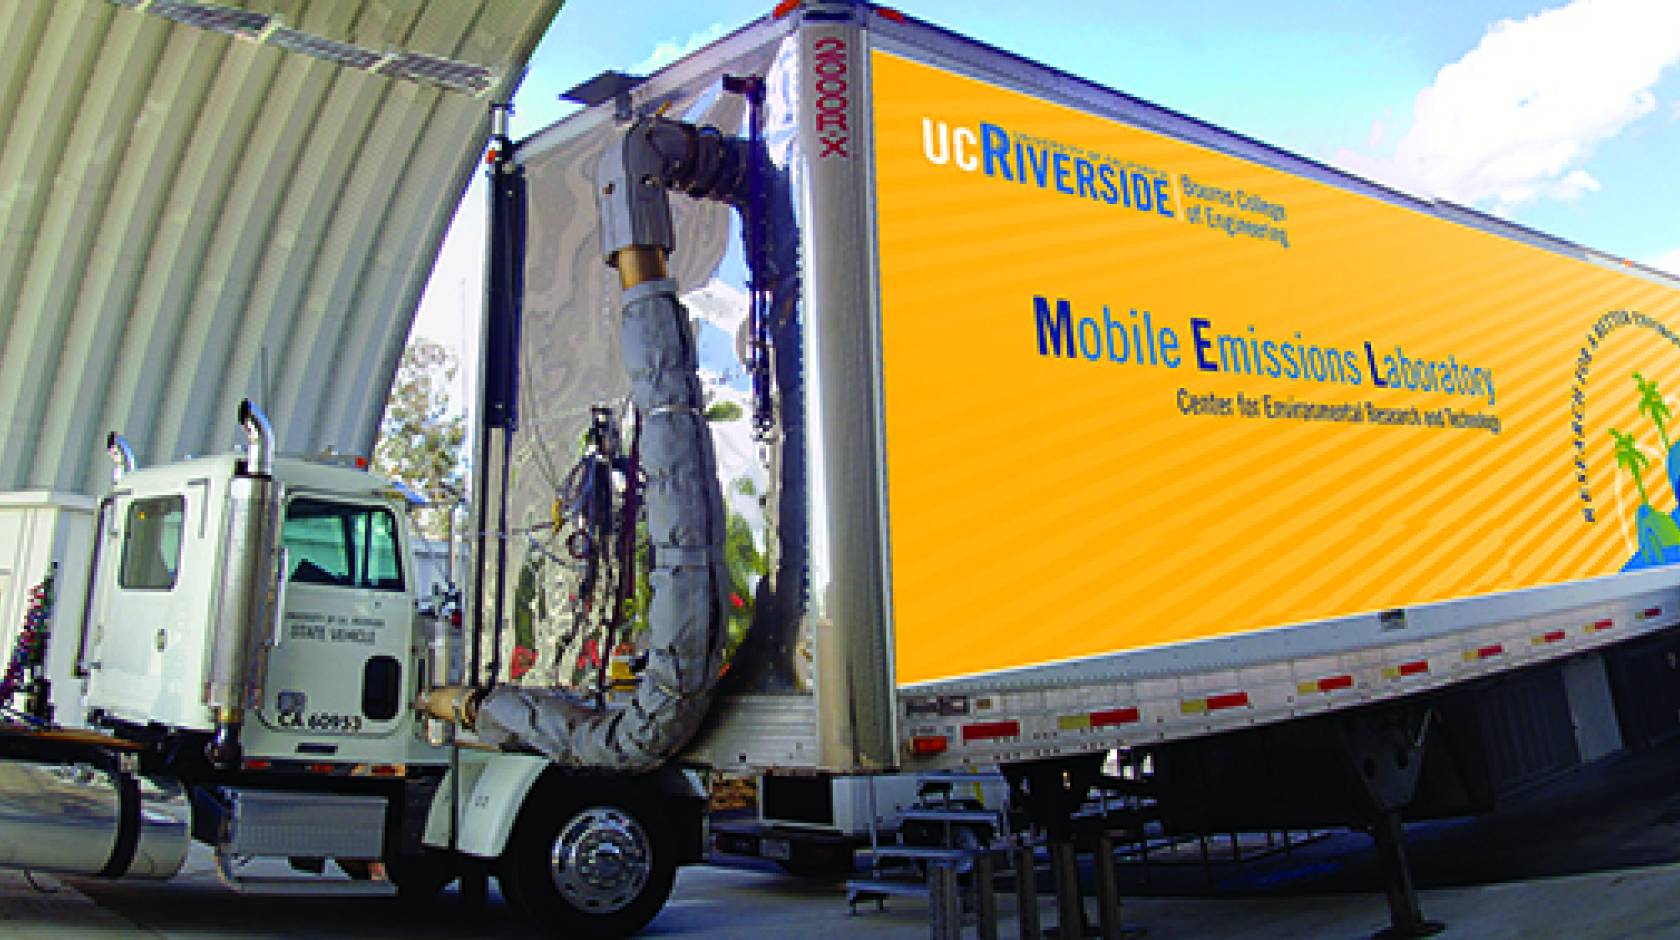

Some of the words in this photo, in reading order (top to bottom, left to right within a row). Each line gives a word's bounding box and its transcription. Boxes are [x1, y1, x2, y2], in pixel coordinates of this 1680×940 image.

[1180, 173, 1235, 208] Bourns
[1236, 189, 1287, 222] College
[1186, 204, 1203, 225] of
[1204, 206, 1290, 249] Engineering
[1033, 294, 1182, 369] Mobile
[1190, 317, 1363, 386] Emissions
[1363, 340, 1496, 405] Laboratory
[1176, 387, 1234, 416] Center
[1236, 391, 1261, 419] for
[1263, 394, 1363, 423] Environmental
[1363, 400, 1422, 426] Research
[1423, 409, 1445, 428] and
[1444, 407, 1500, 434] Technology
